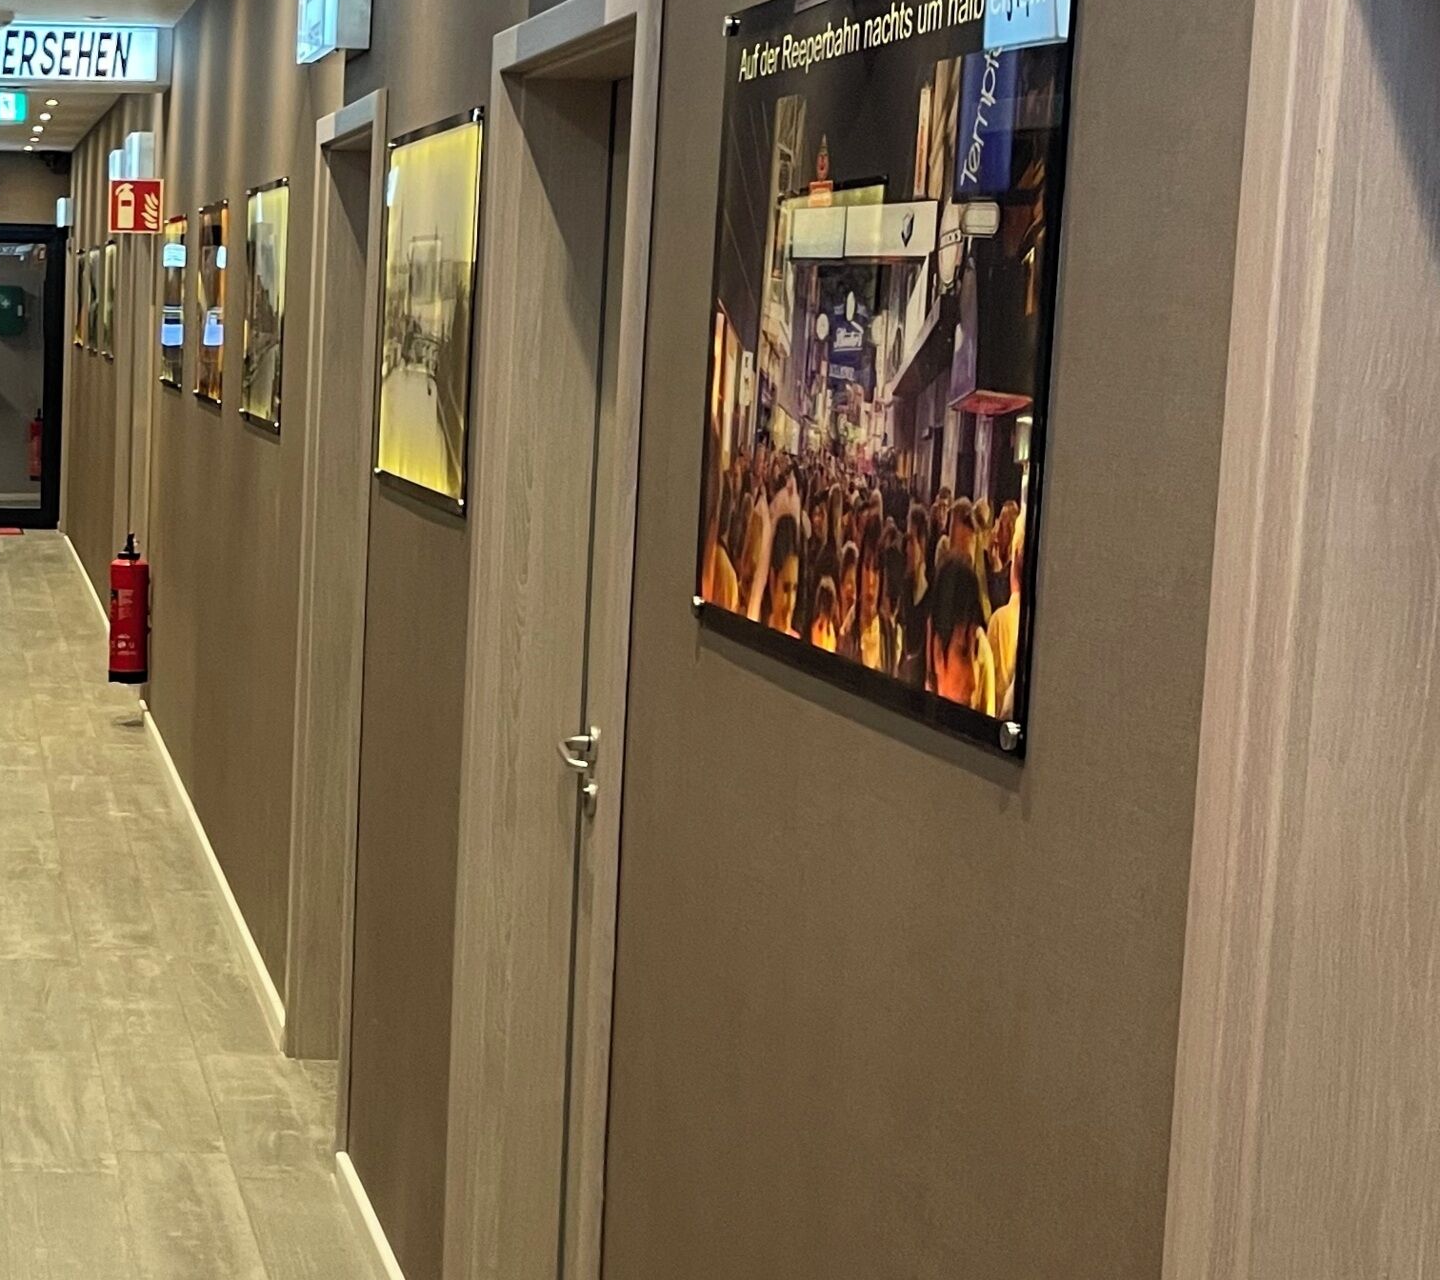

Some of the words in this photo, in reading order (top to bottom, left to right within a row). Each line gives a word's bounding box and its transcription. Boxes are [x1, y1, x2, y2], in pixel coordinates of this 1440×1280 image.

[738, 43, 760, 82] Auf
[760, 41, 781, 77] der
[781, 17, 860, 74] Reeperbahn
[863, 1, 913, 49] nachts
